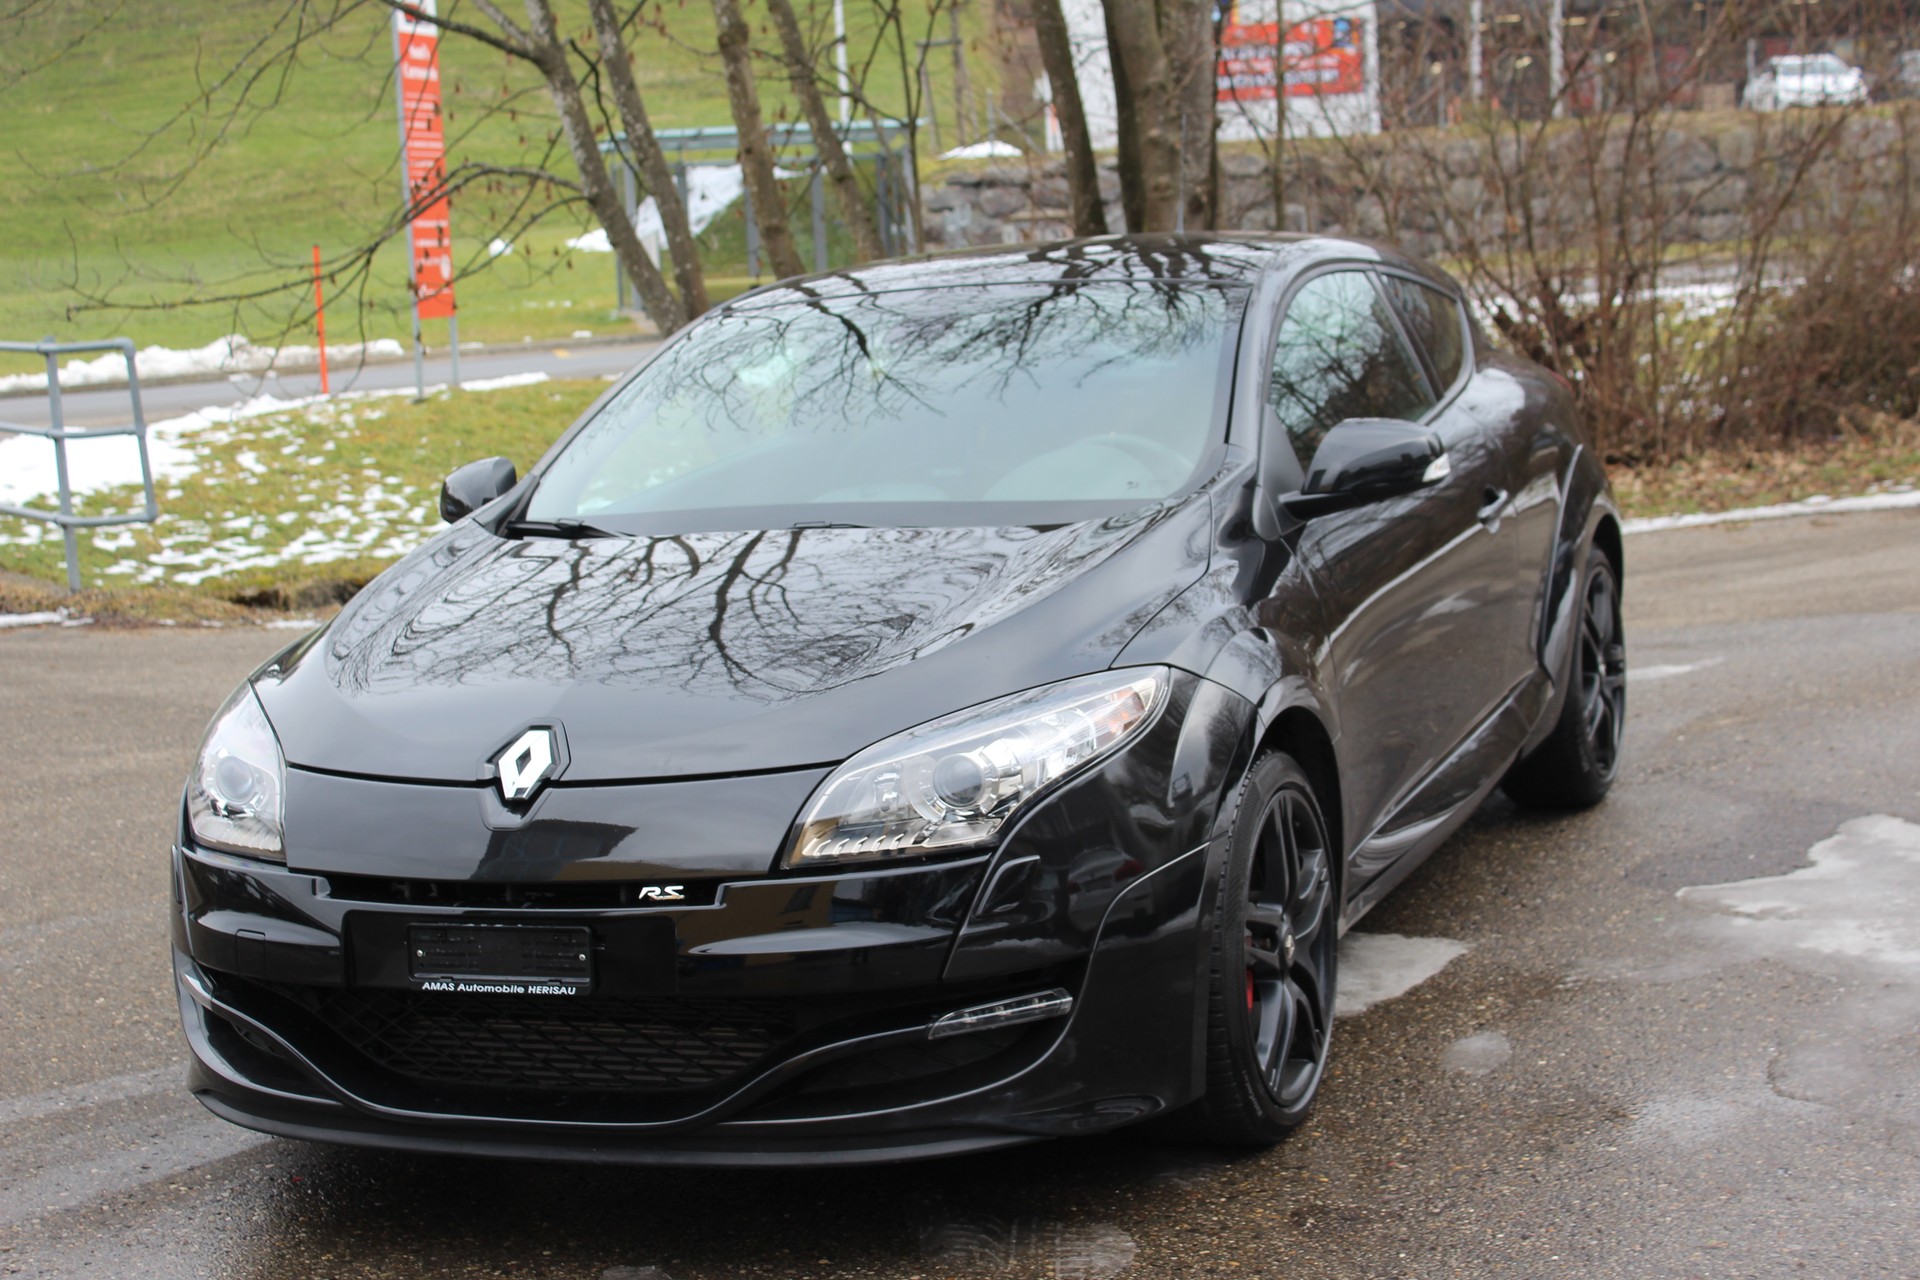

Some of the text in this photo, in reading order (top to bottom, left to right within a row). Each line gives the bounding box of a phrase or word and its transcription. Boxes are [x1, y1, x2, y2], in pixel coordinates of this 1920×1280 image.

[422, 982, 577, 995] AMAS Automobile HERISAU
